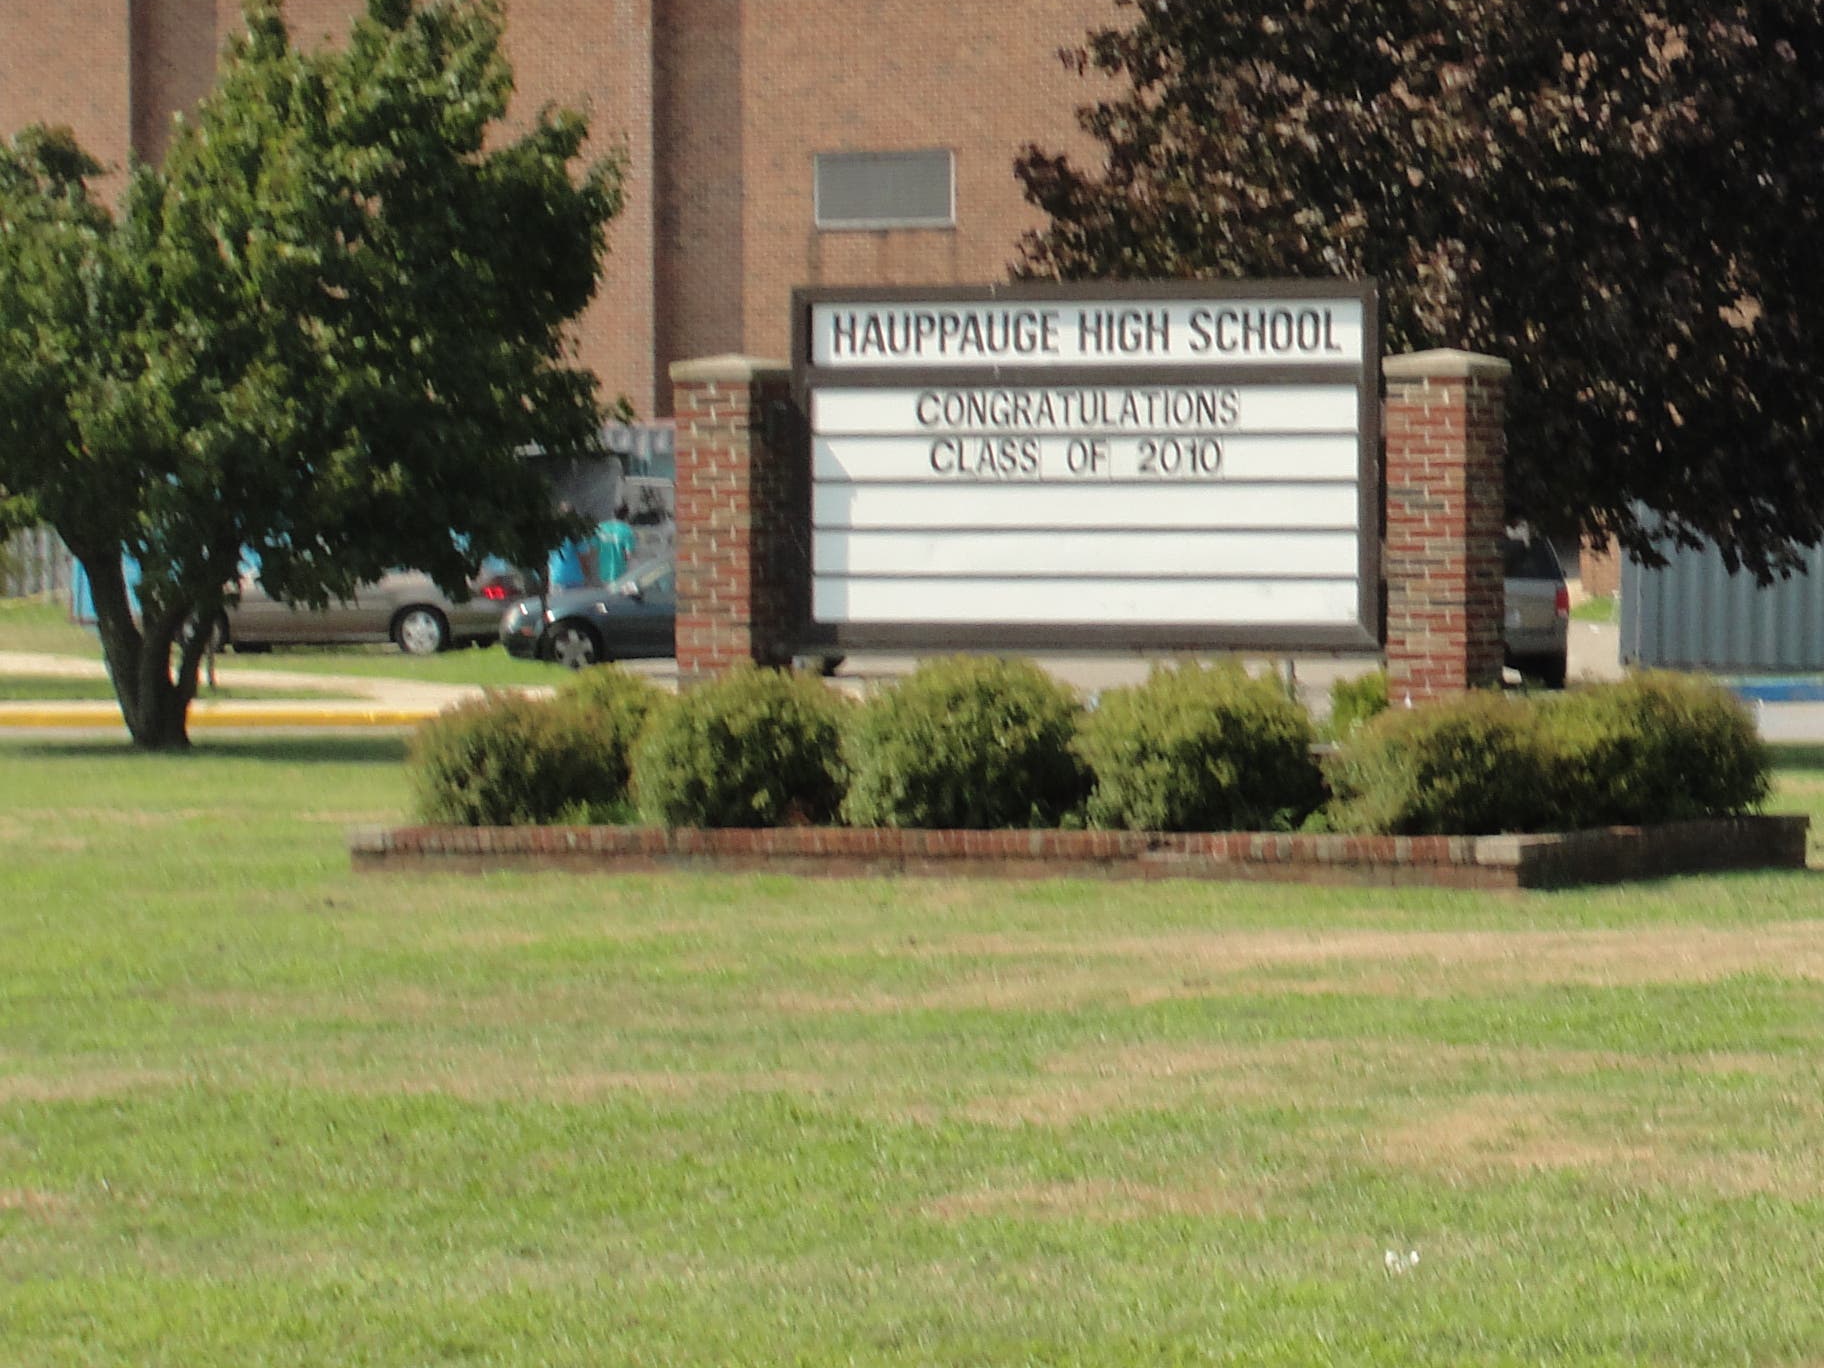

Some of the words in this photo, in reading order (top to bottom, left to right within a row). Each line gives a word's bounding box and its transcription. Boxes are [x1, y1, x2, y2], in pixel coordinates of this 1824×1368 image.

[832, 310, 1060, 356] HAUPPAUGE
[1077, 309, 1170, 354] HIGH
[1188, 307, 1342, 353] SCHOOL
[916, 390, 1240, 427] CONGRATULATIONS
[930, 437, 1038, 474] CLASS
[1066, 437, 1107, 474] OF
[1138, 436, 1223, 474] 2010
